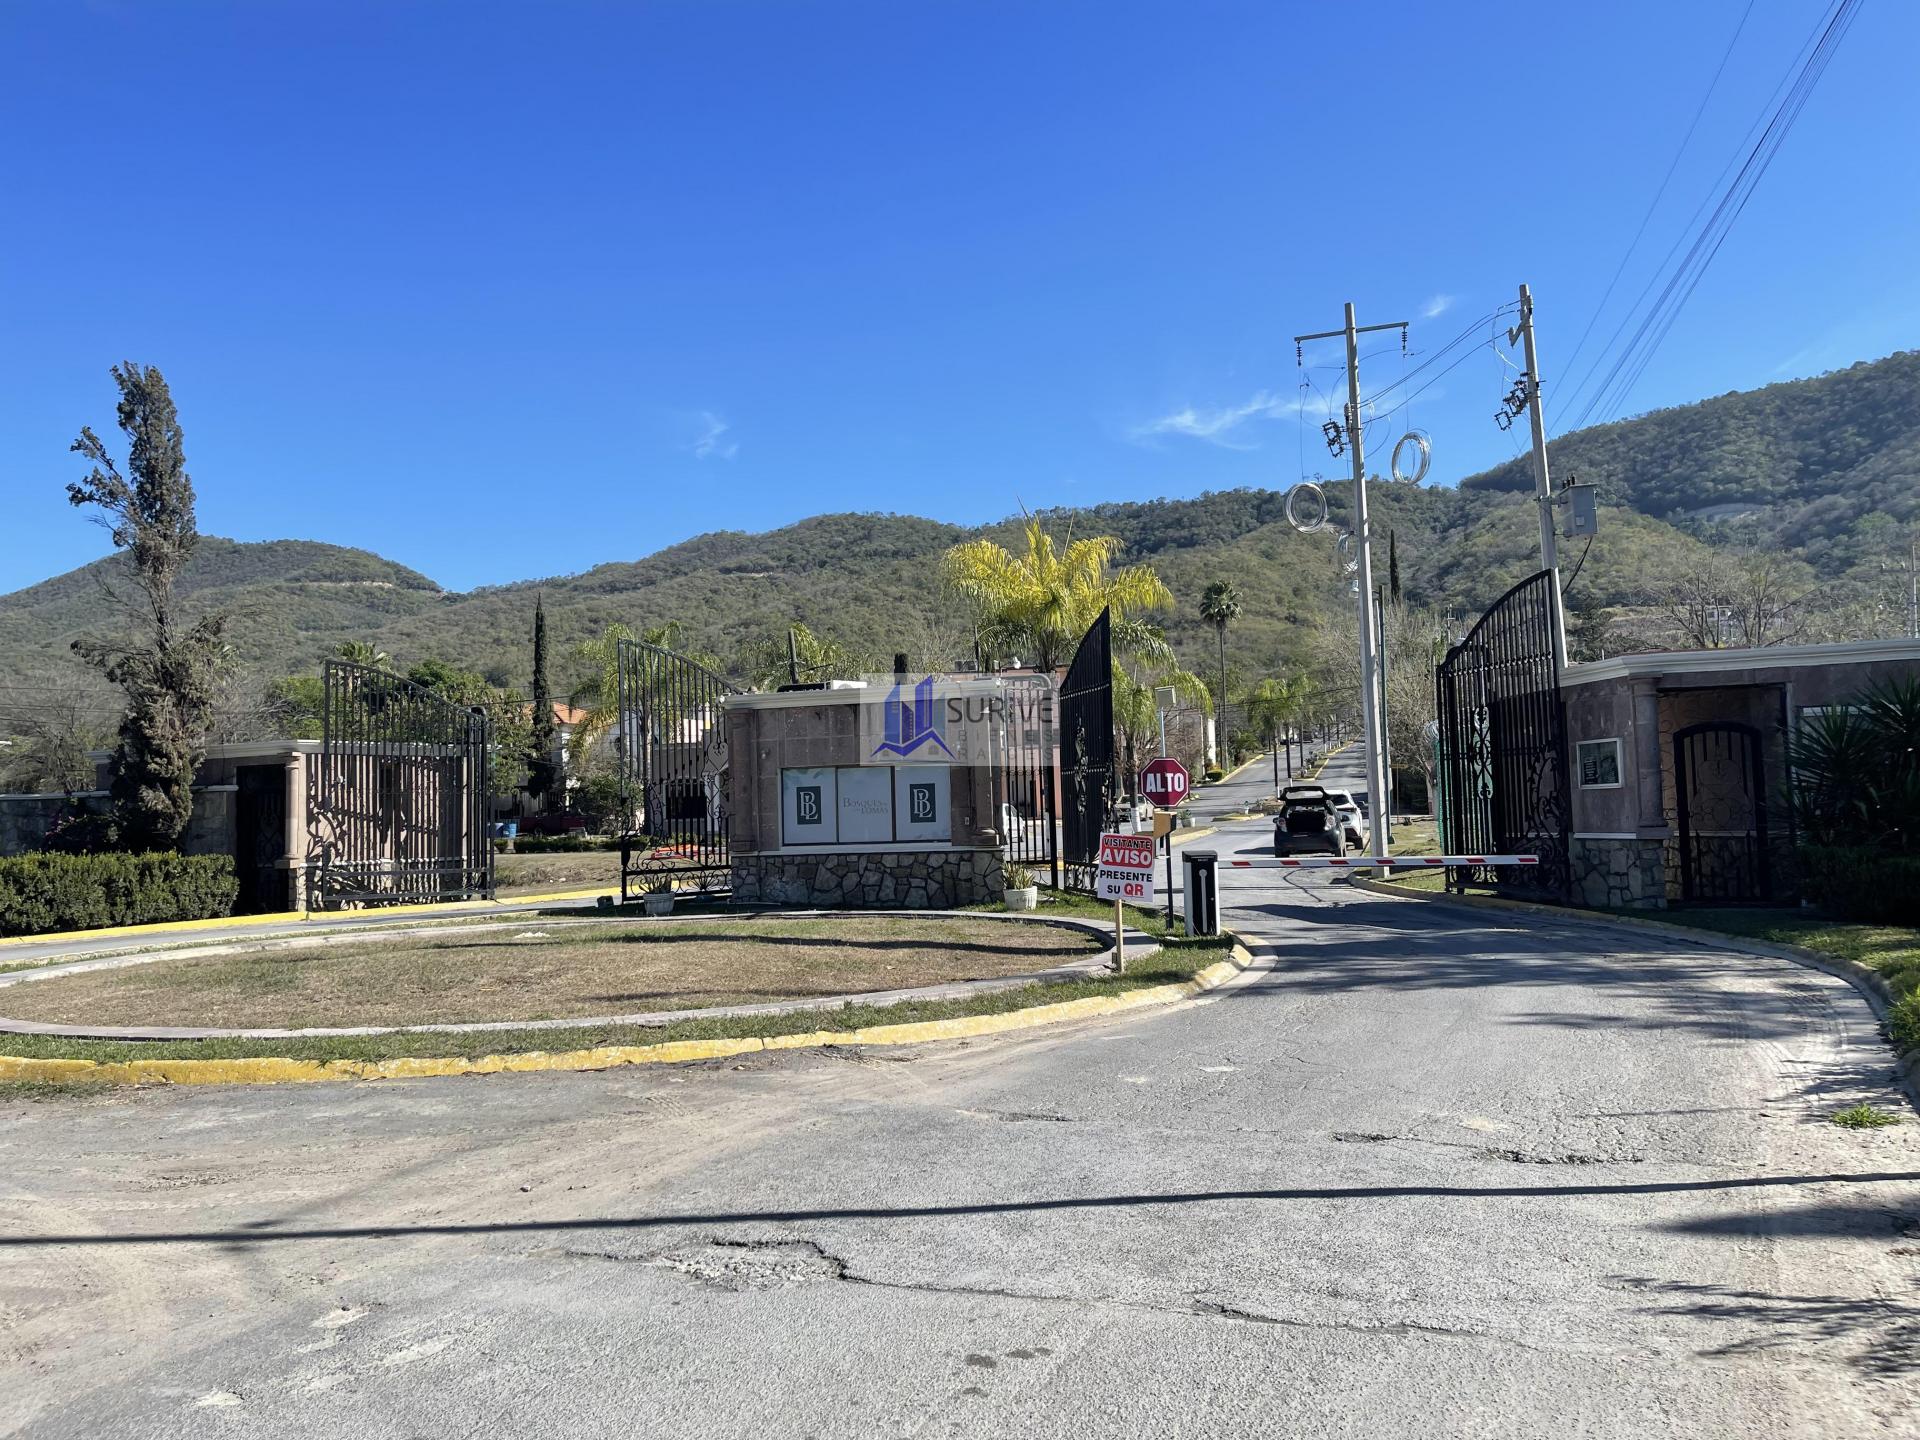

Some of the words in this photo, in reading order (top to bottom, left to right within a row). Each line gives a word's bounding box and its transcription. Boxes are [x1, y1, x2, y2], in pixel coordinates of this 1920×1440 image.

[1145, 772, 1185, 793] ALTO
[1104, 838, 1151, 850] VISITANTE
[1102, 849, 1152, 865] AVISO
[1100, 869, 1153, 883] PRESENTE
[1107, 884, 1121, 895] SU
[1124, 882, 1144, 897] QR
